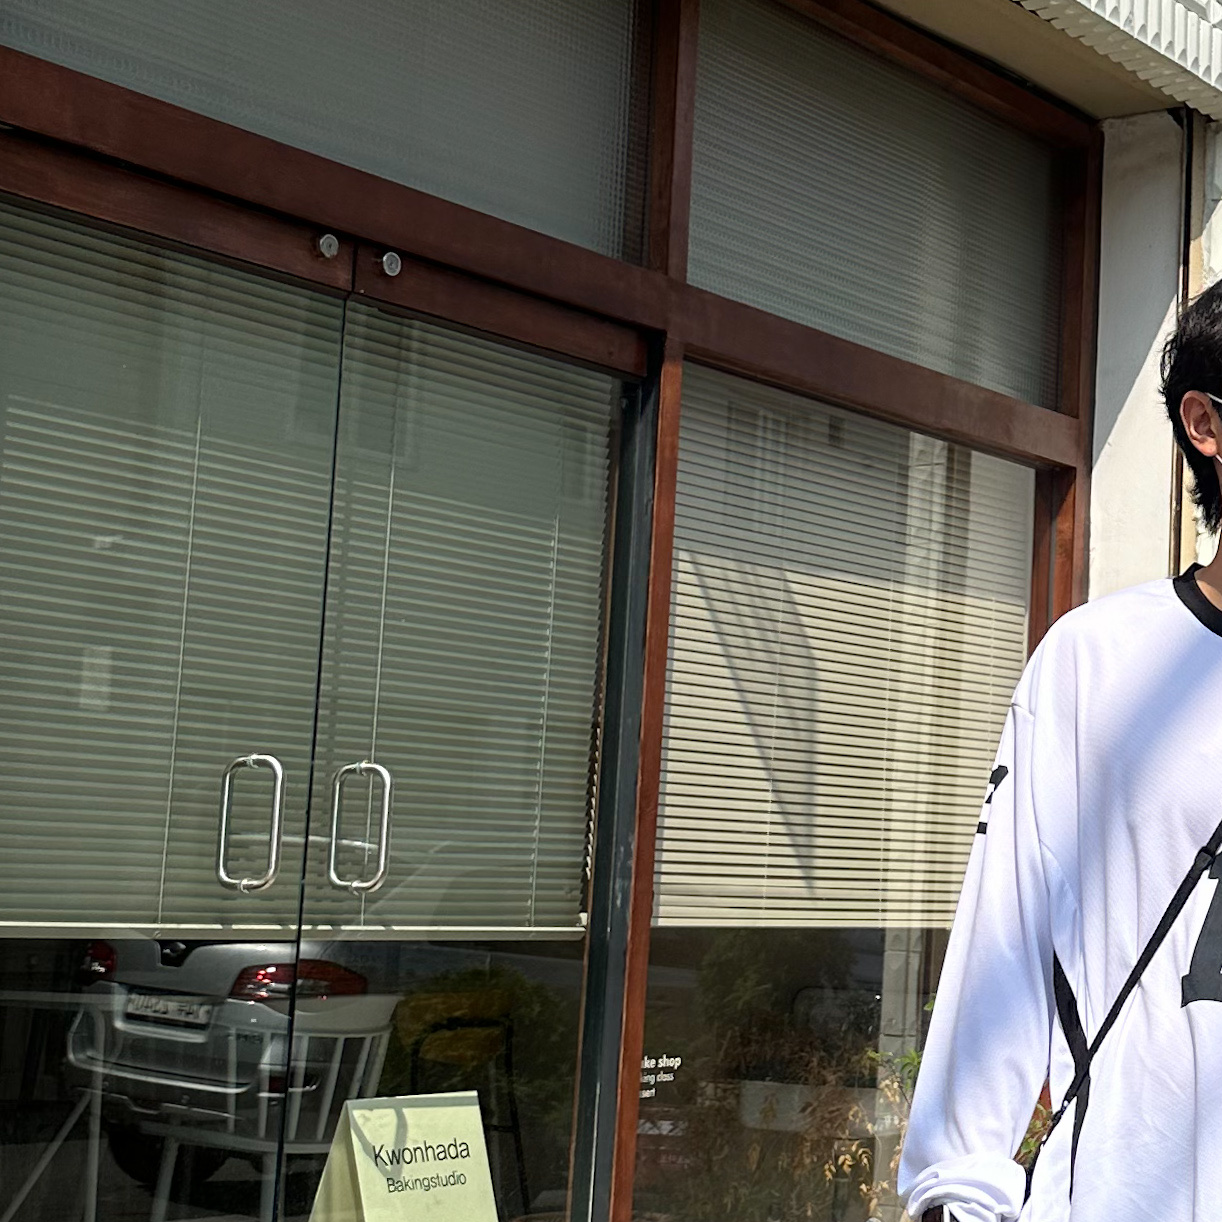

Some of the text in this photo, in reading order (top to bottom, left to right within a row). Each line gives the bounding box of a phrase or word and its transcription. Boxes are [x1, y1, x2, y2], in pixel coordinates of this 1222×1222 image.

[657, 1053, 682, 1070] shop
[373, 1138, 470, 1167] Kwonhada
[387, 1171, 466, 1193] Bakingstudio
